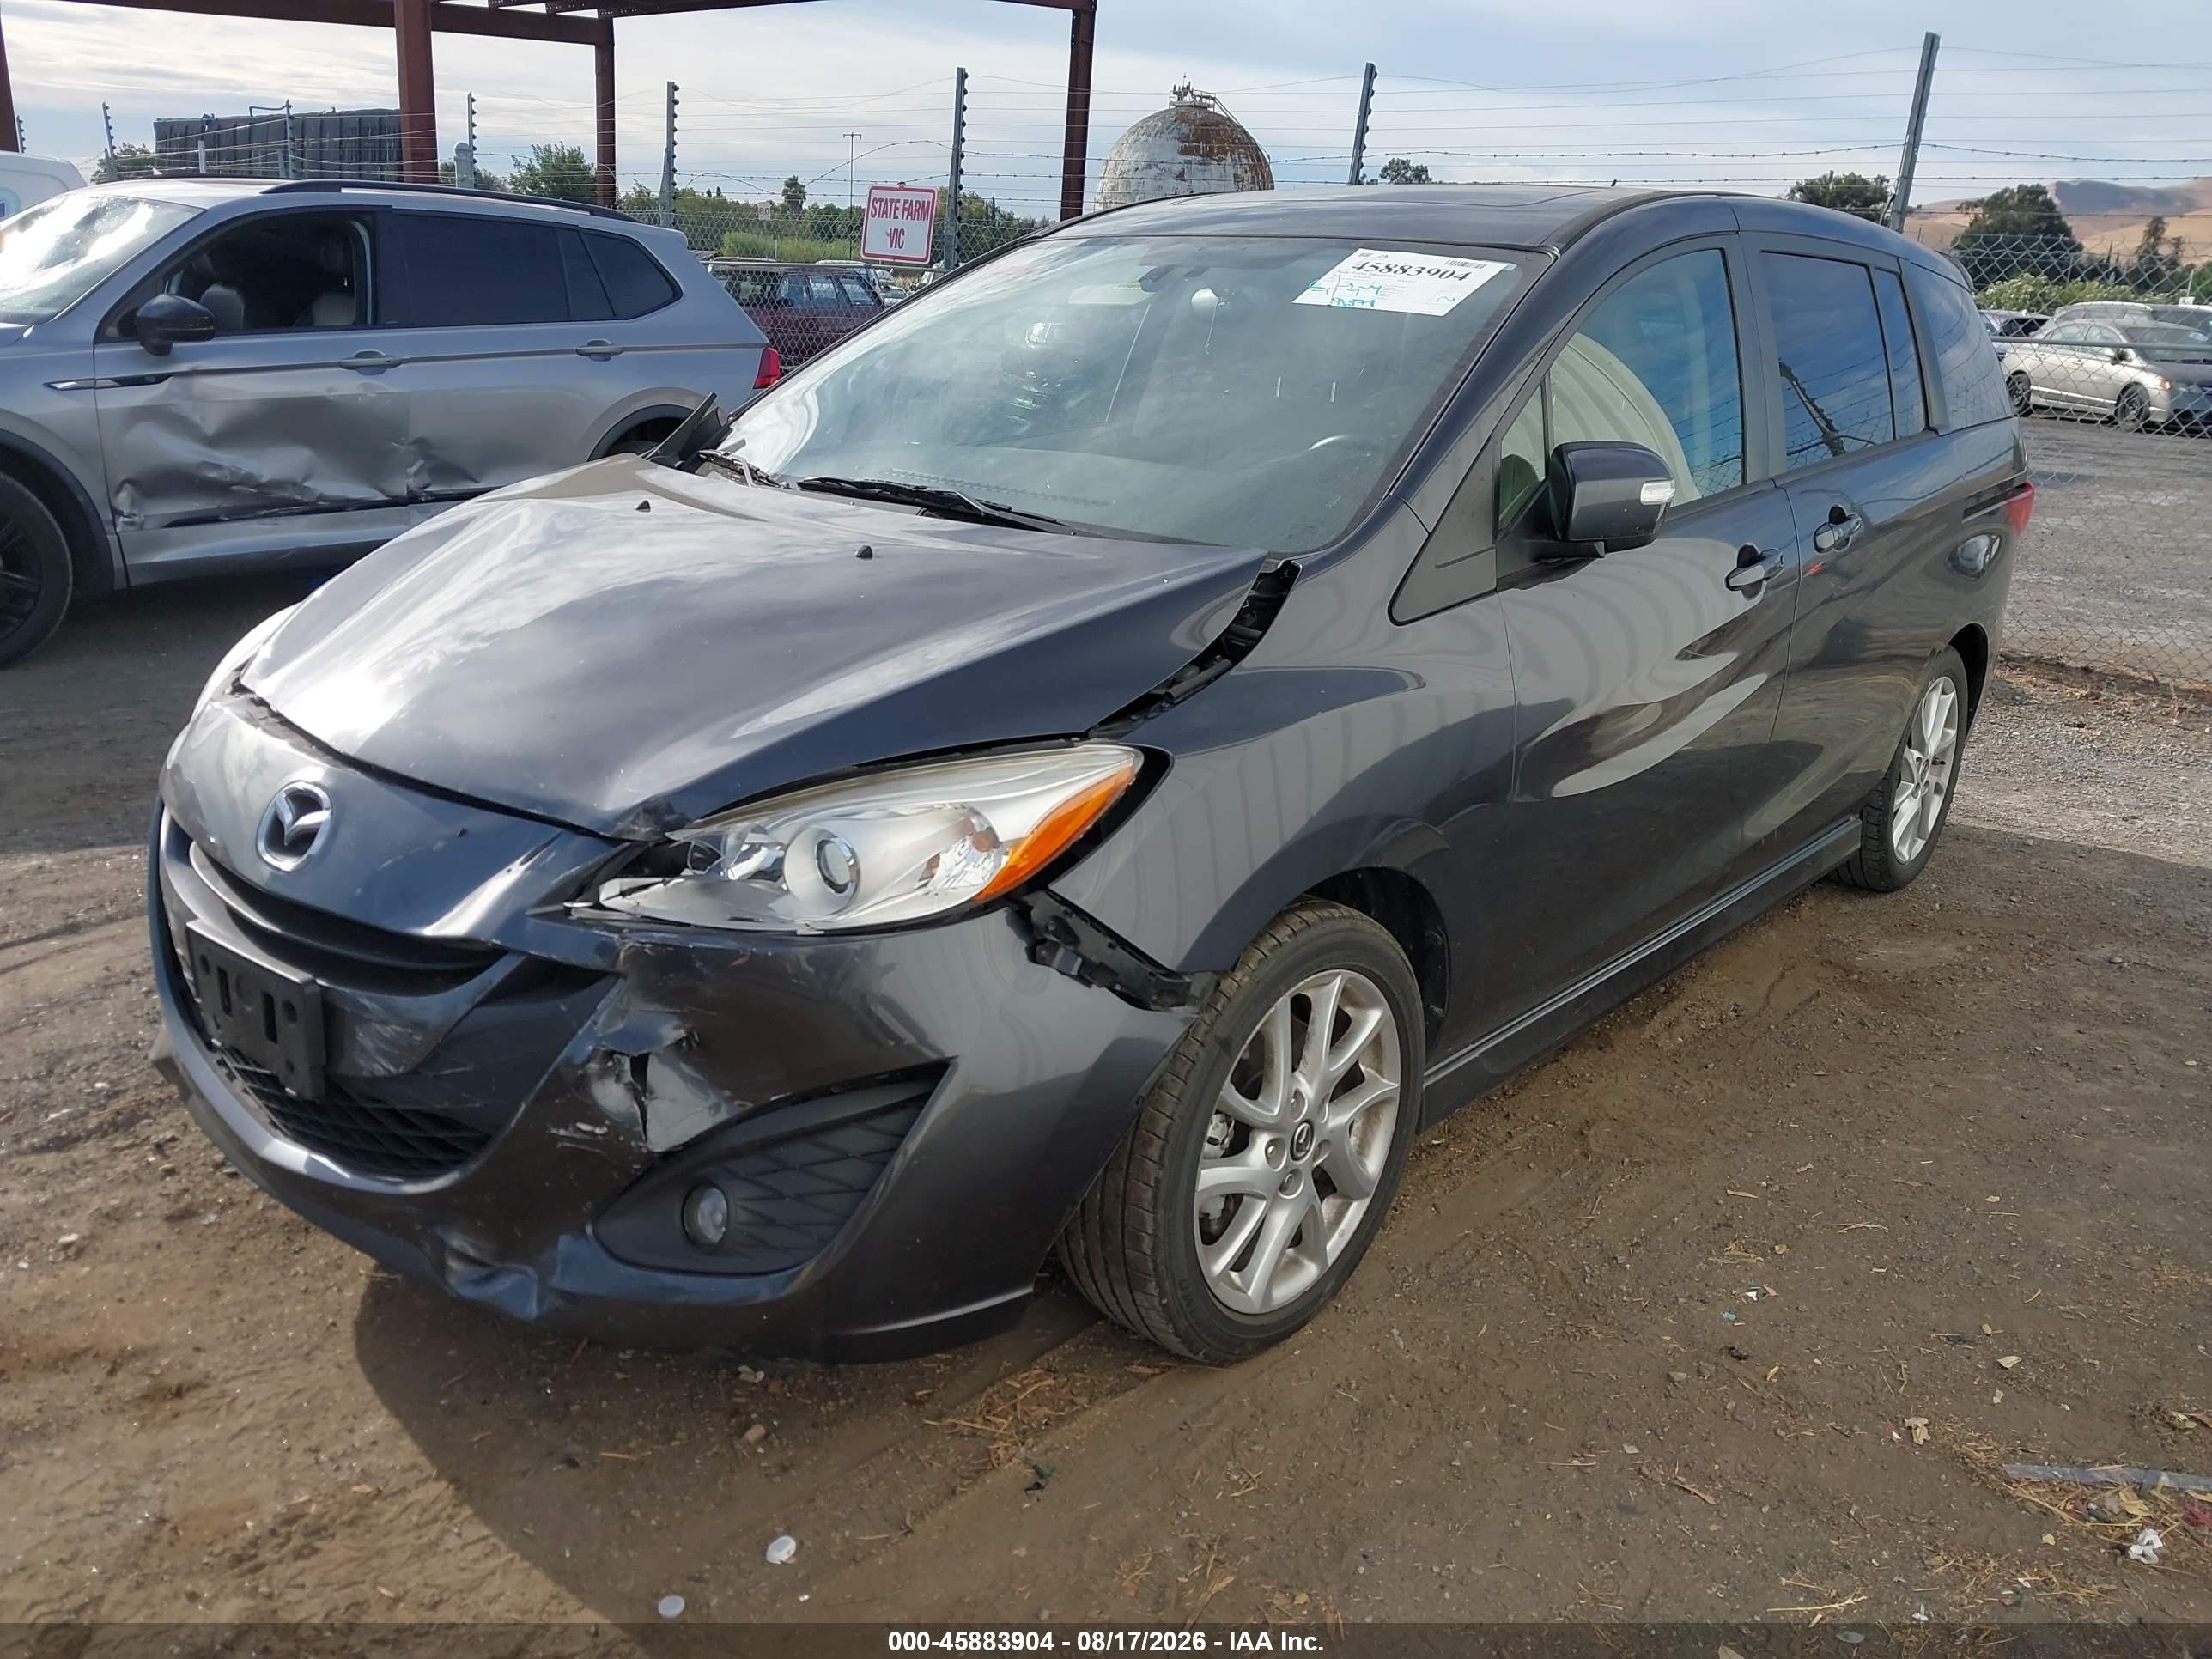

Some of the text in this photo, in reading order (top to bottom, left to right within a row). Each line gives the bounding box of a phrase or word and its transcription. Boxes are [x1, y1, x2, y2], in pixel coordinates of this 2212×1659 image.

[871, 197, 931, 222] STATE FARM
[888, 227, 905, 250] VIC
[1351, 260, 1473, 282] 45883904
